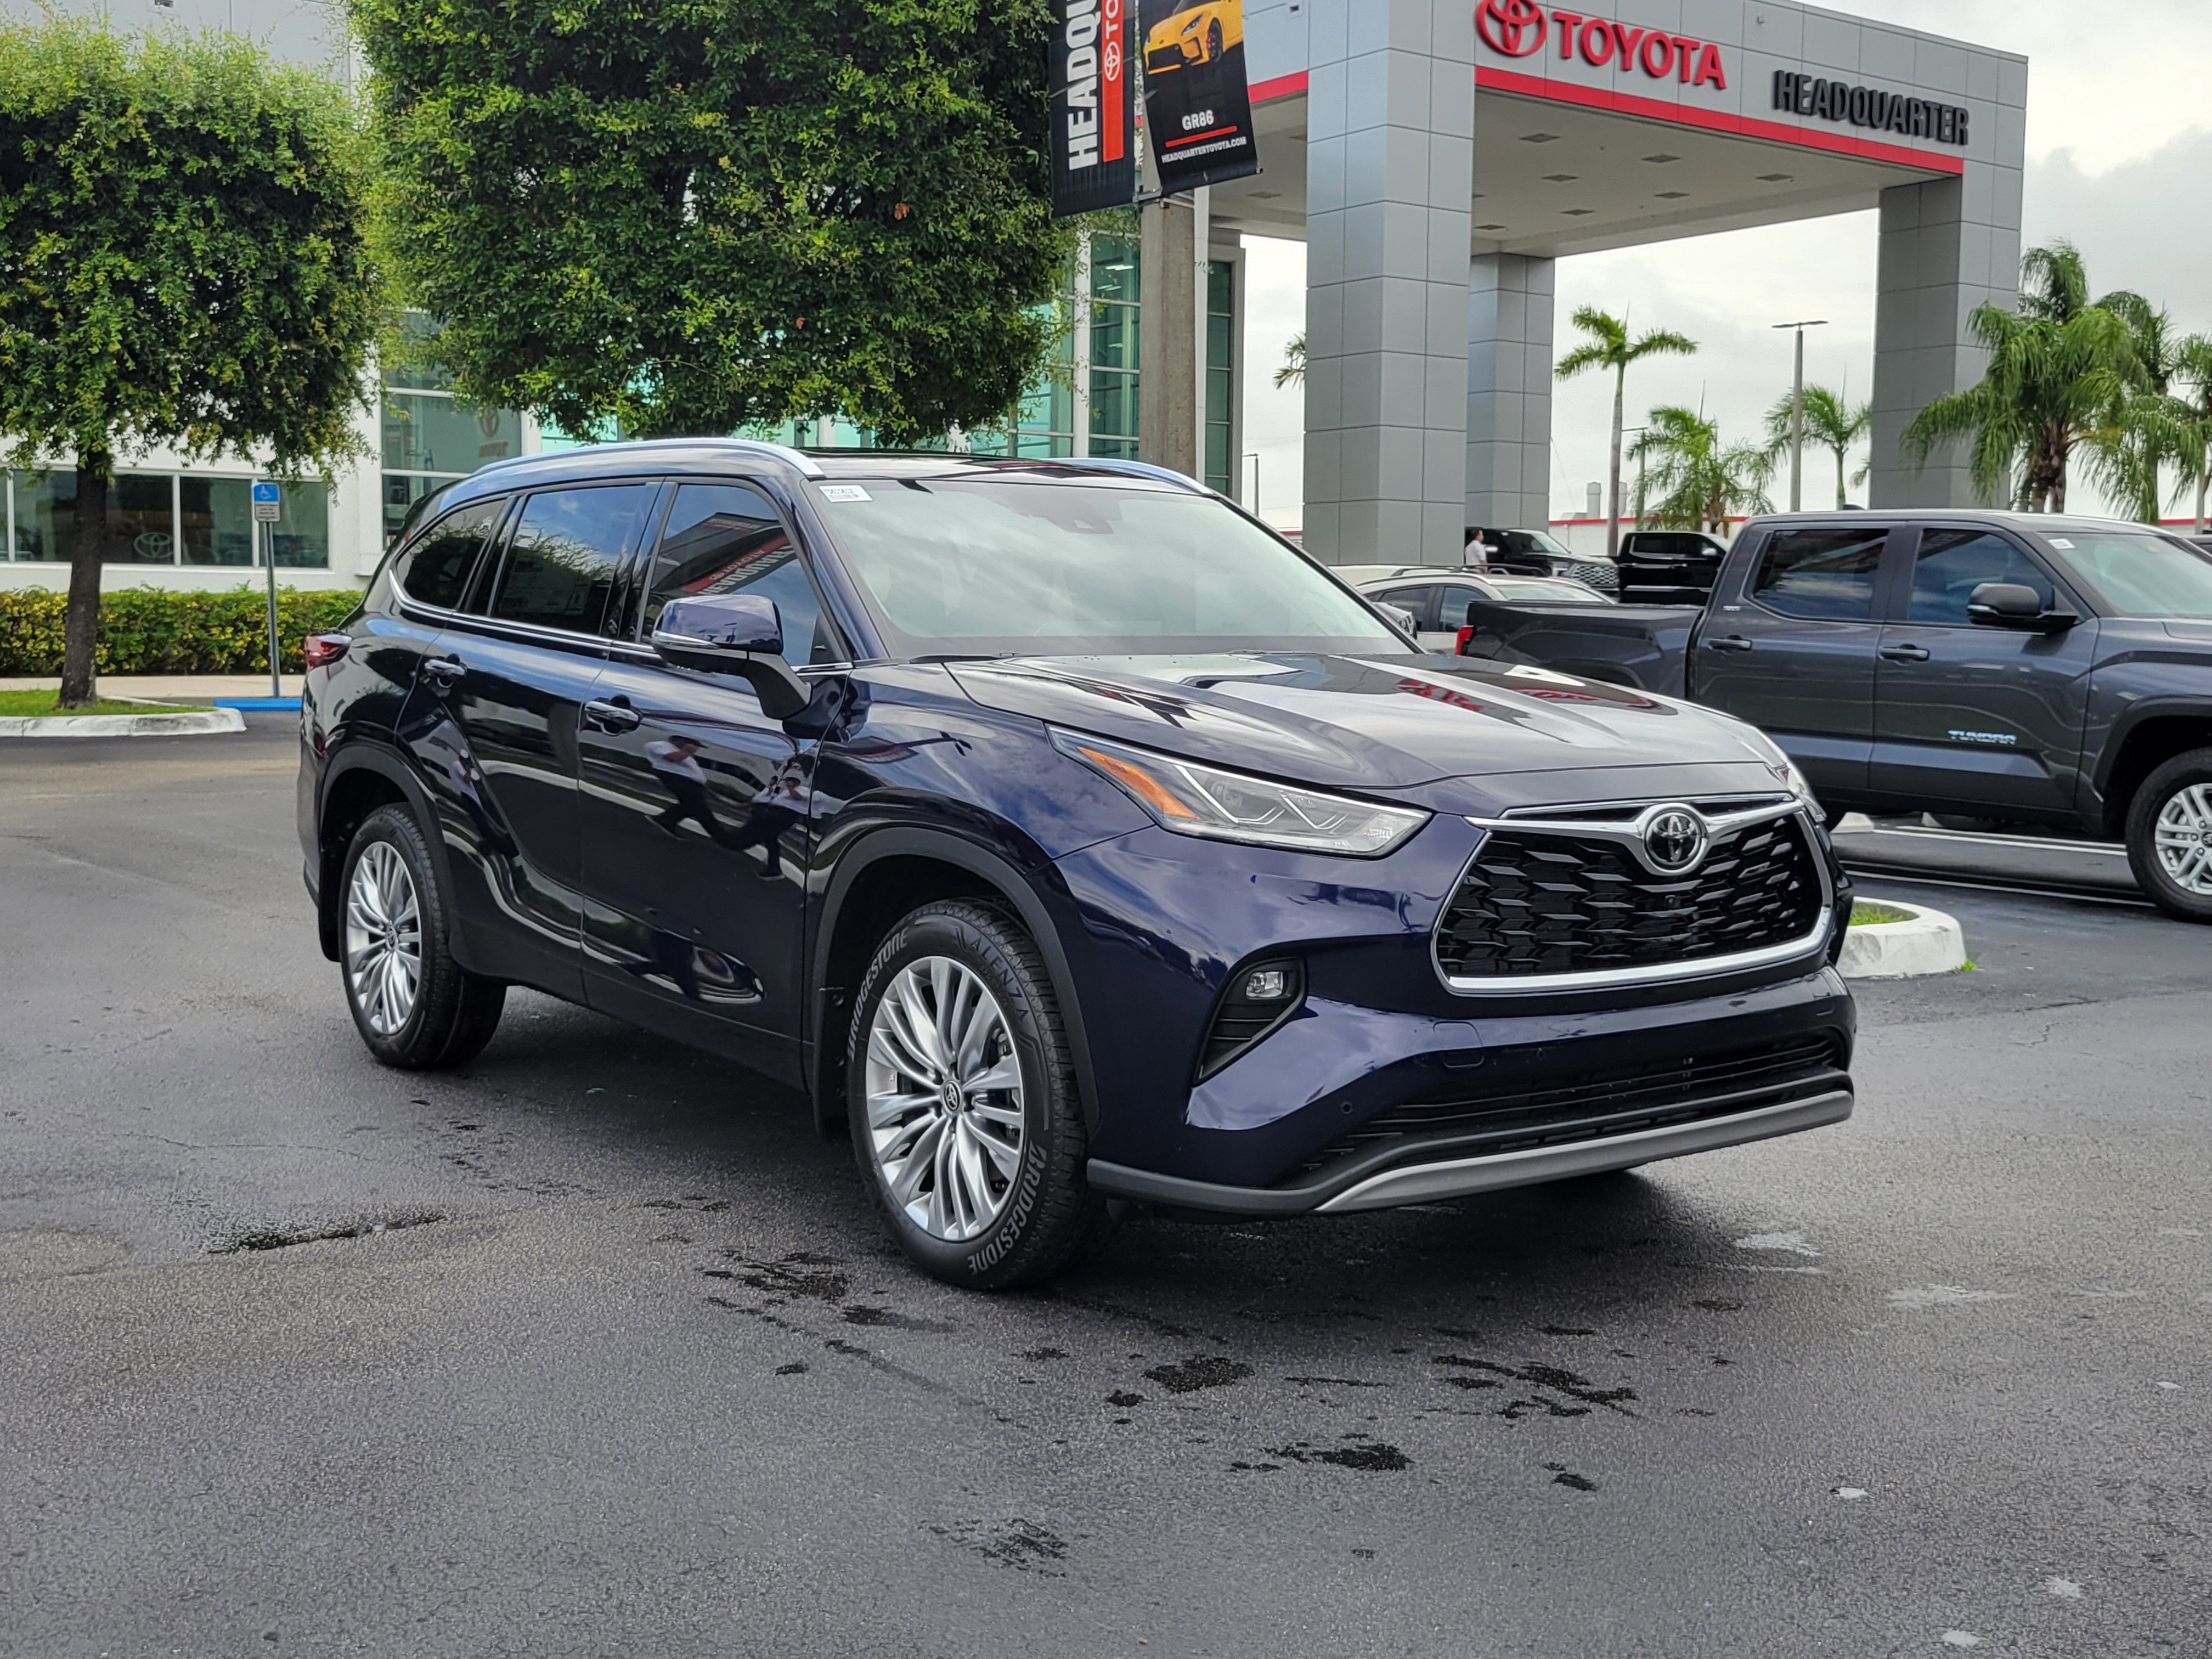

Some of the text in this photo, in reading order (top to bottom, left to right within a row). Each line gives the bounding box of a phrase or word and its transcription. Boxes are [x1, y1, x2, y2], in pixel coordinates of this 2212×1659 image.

[1553, 11, 1726, 90] TOYOTA
[1182, 110, 1215, 131] GR86
[1774, 70, 1969, 145] HEADQUARTER
[1161, 136, 1247, 164] HEADQUARTERTOYOTA.COM
[1948, 730, 2017, 745] TUNDRA
[847, 927, 909, 1063] BRIDGESTONE
[970, 938, 1029, 1023] ALENZA
[967, 1139, 1047, 1276] BRIDGESTONE
